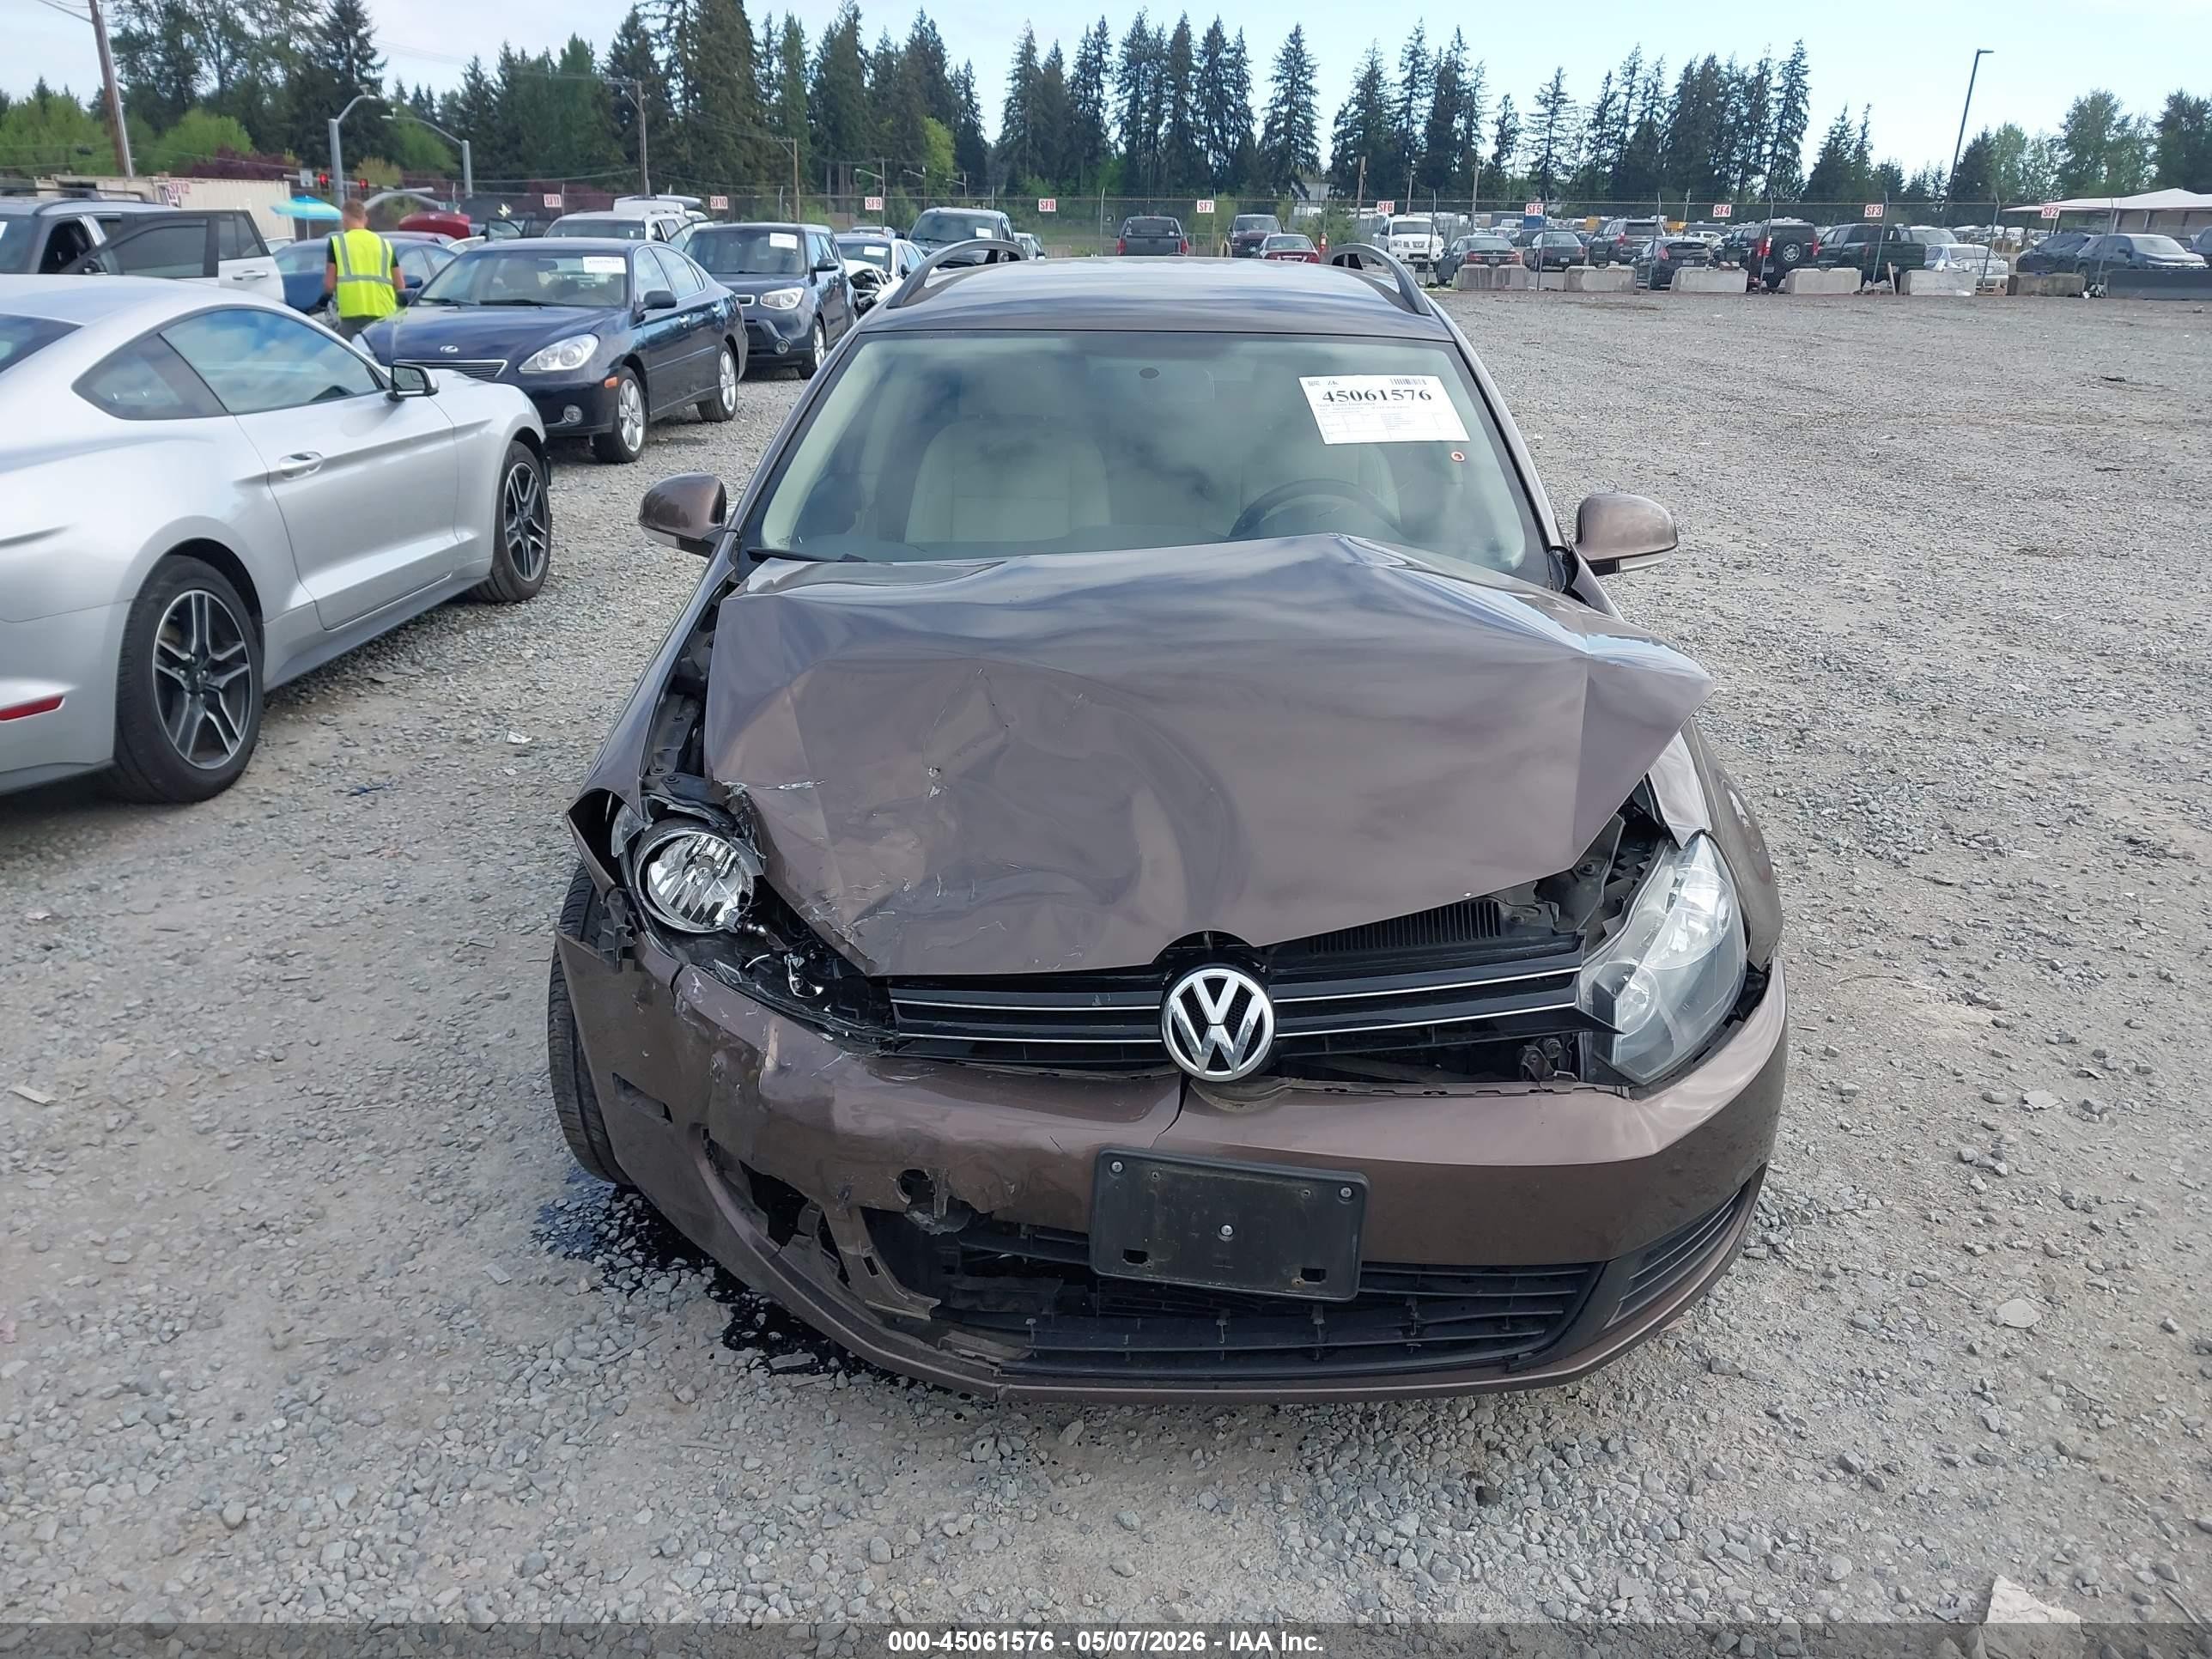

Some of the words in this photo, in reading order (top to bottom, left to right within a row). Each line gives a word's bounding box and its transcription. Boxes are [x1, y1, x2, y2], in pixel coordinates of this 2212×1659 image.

[710, 198, 727, 208] SF10
[866, 198, 881, 210] SF9
[1198, 201, 1212, 212] SF7
[1377, 202, 1393, 213] SF6
[1526, 204, 1542, 215] SF5
[1714, 204, 1730, 216] SF4
[1866, 205, 1881, 216] SF3
[2042, 206, 2059, 217] SF2
[1322, 389, 1432, 403] 45061576
